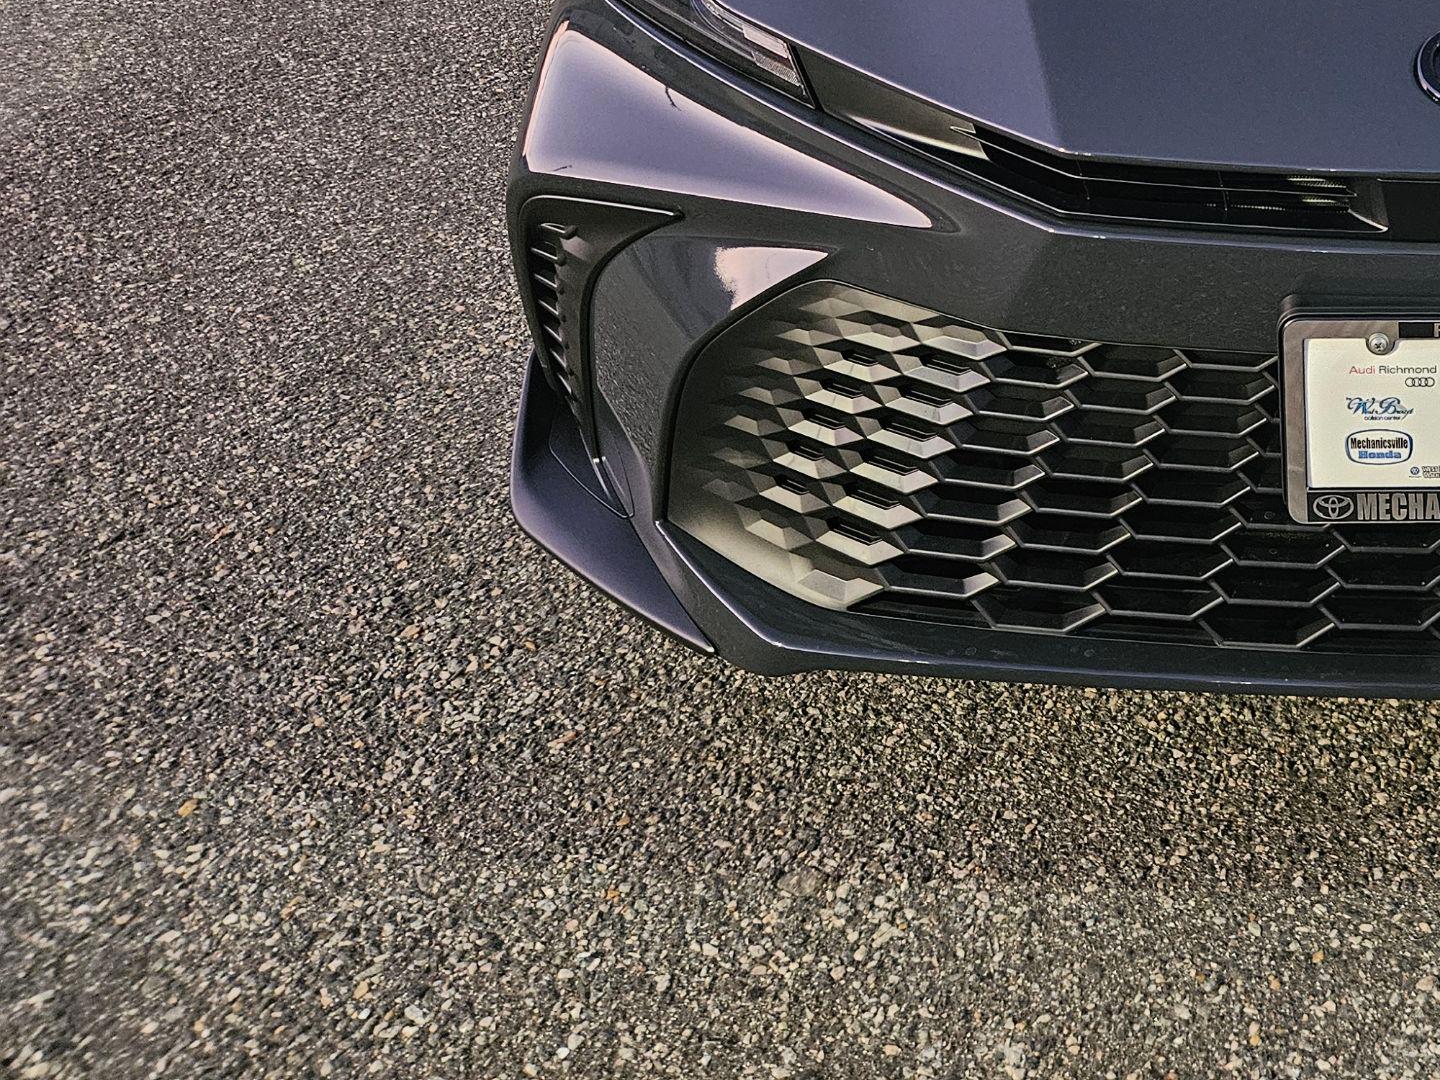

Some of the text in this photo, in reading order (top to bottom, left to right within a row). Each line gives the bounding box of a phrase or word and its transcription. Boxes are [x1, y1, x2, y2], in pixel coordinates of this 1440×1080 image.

[1349, 364, 1438, 375] Audi Richmond
[1350, 437, 1409, 450] Mechanicsville
[1358, 450, 1402, 459] Honda
